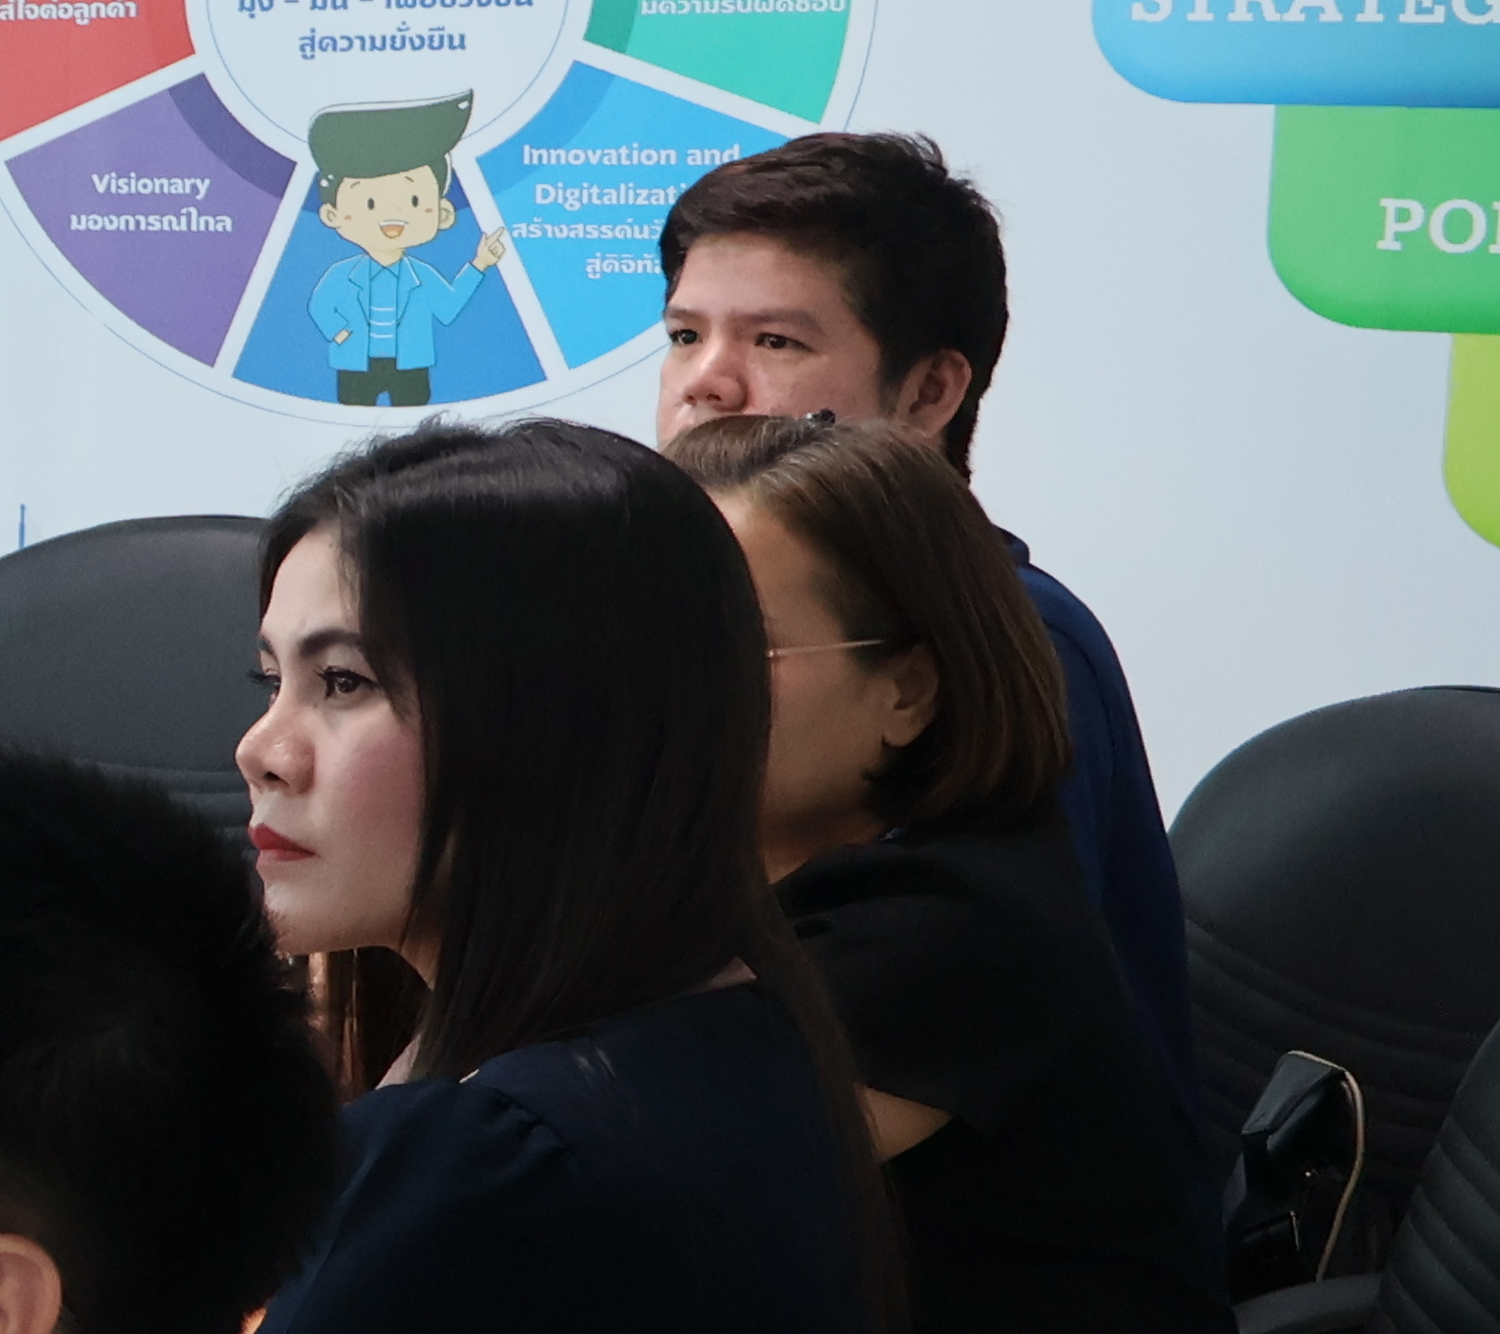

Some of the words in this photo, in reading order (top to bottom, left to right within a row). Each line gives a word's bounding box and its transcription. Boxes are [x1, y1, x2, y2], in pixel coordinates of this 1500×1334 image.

[298, 21, 467, 60] สู่ความยั่งยืน
[523, 143, 677, 166] Innovation
[686, 144, 741, 166] and
[91, 171, 211, 200] Visionary
